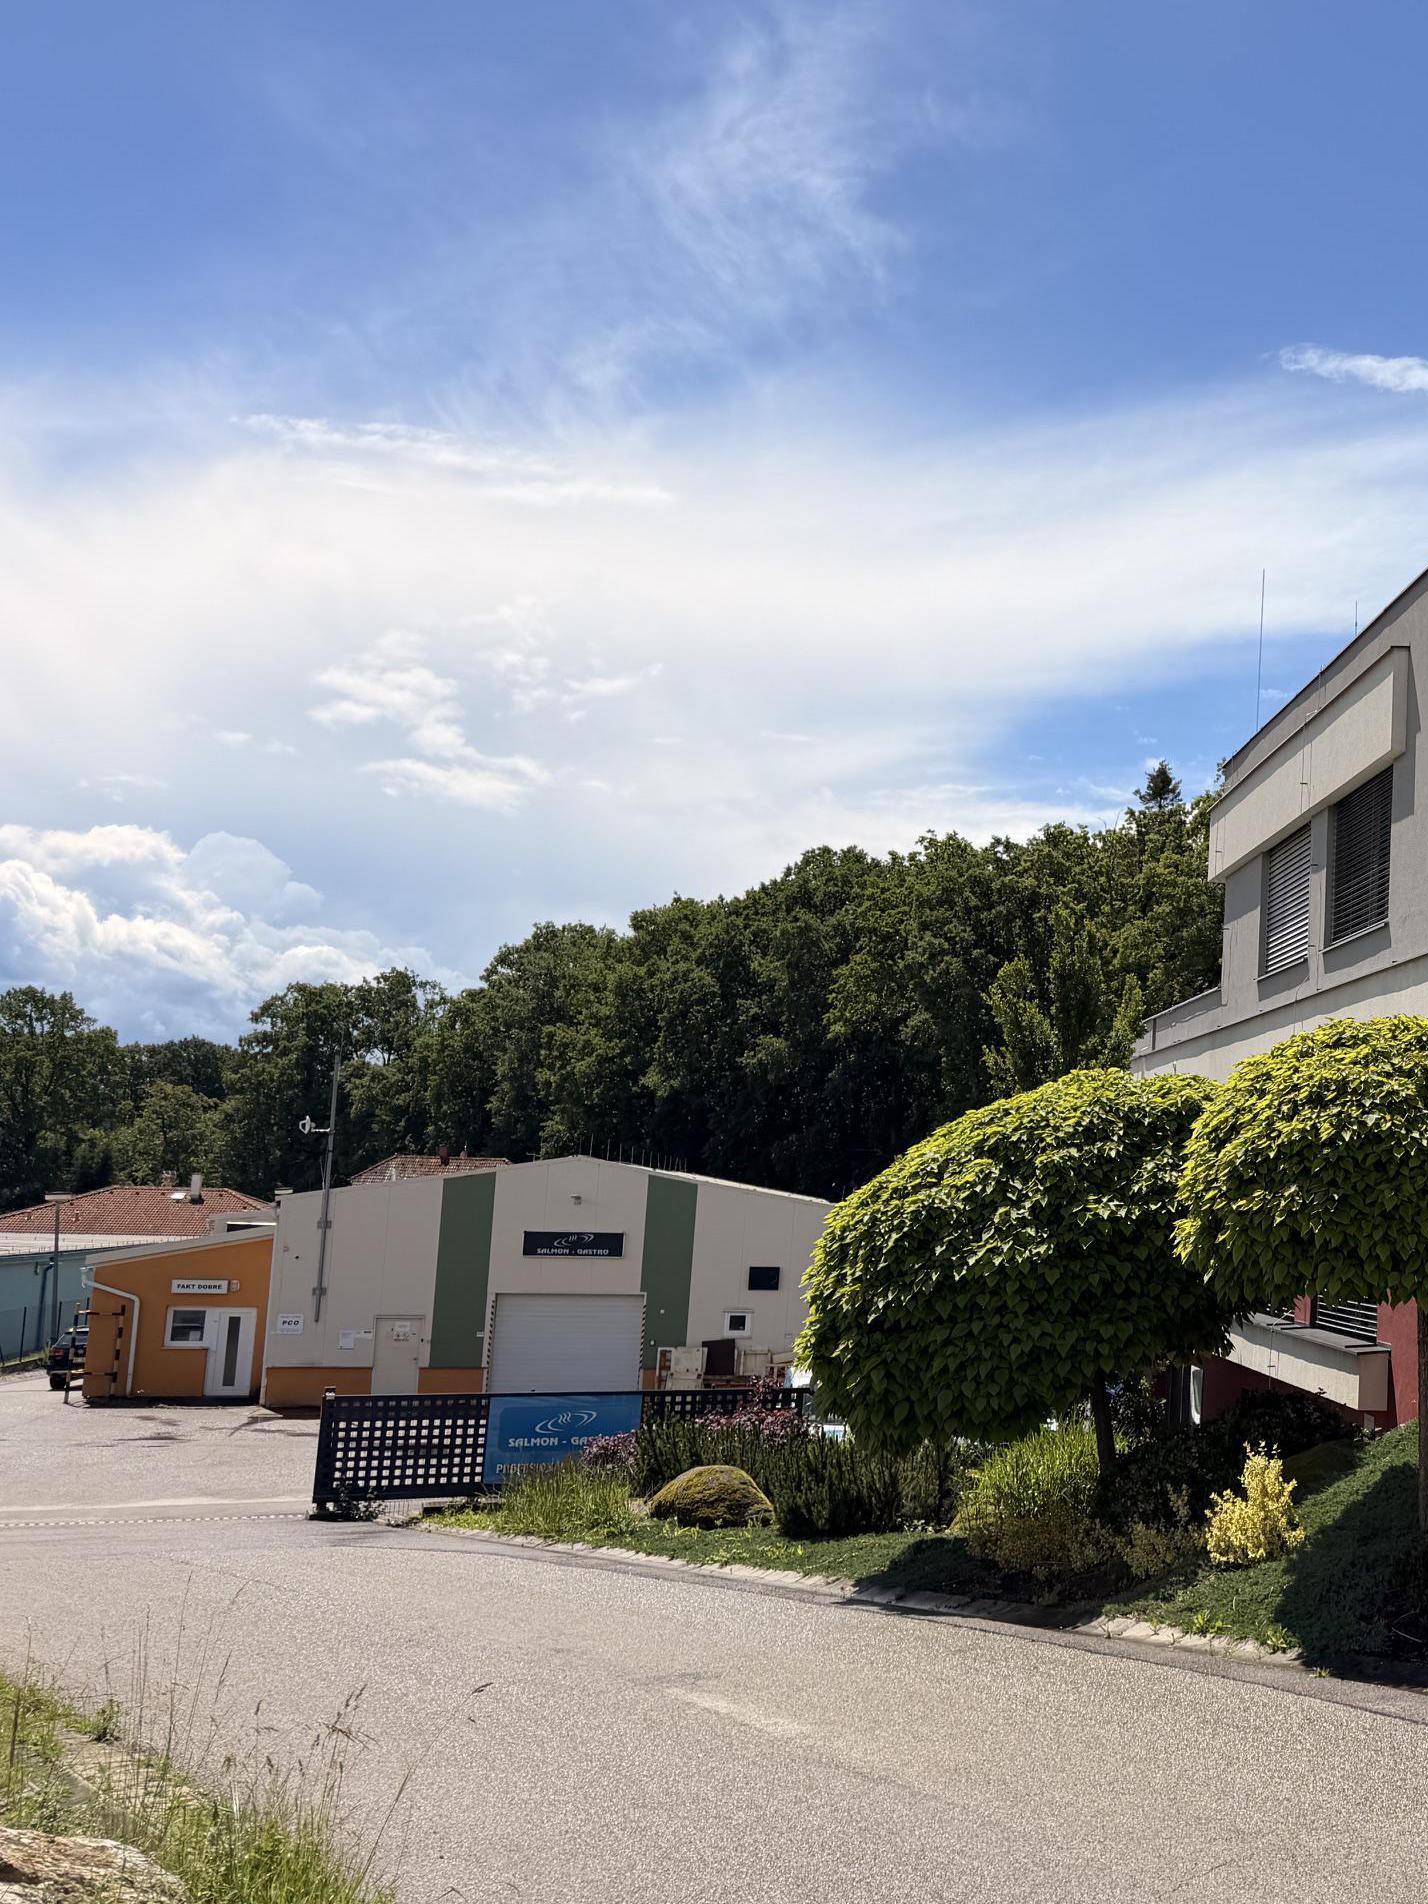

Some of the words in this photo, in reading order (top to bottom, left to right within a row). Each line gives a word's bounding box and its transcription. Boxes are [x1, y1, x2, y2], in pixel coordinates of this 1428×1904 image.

[536, 1247, 570, 1255] SALMON
[576, 1248, 609, 1256] GASTRO
[508, 1436, 559, 1448] SALMON
